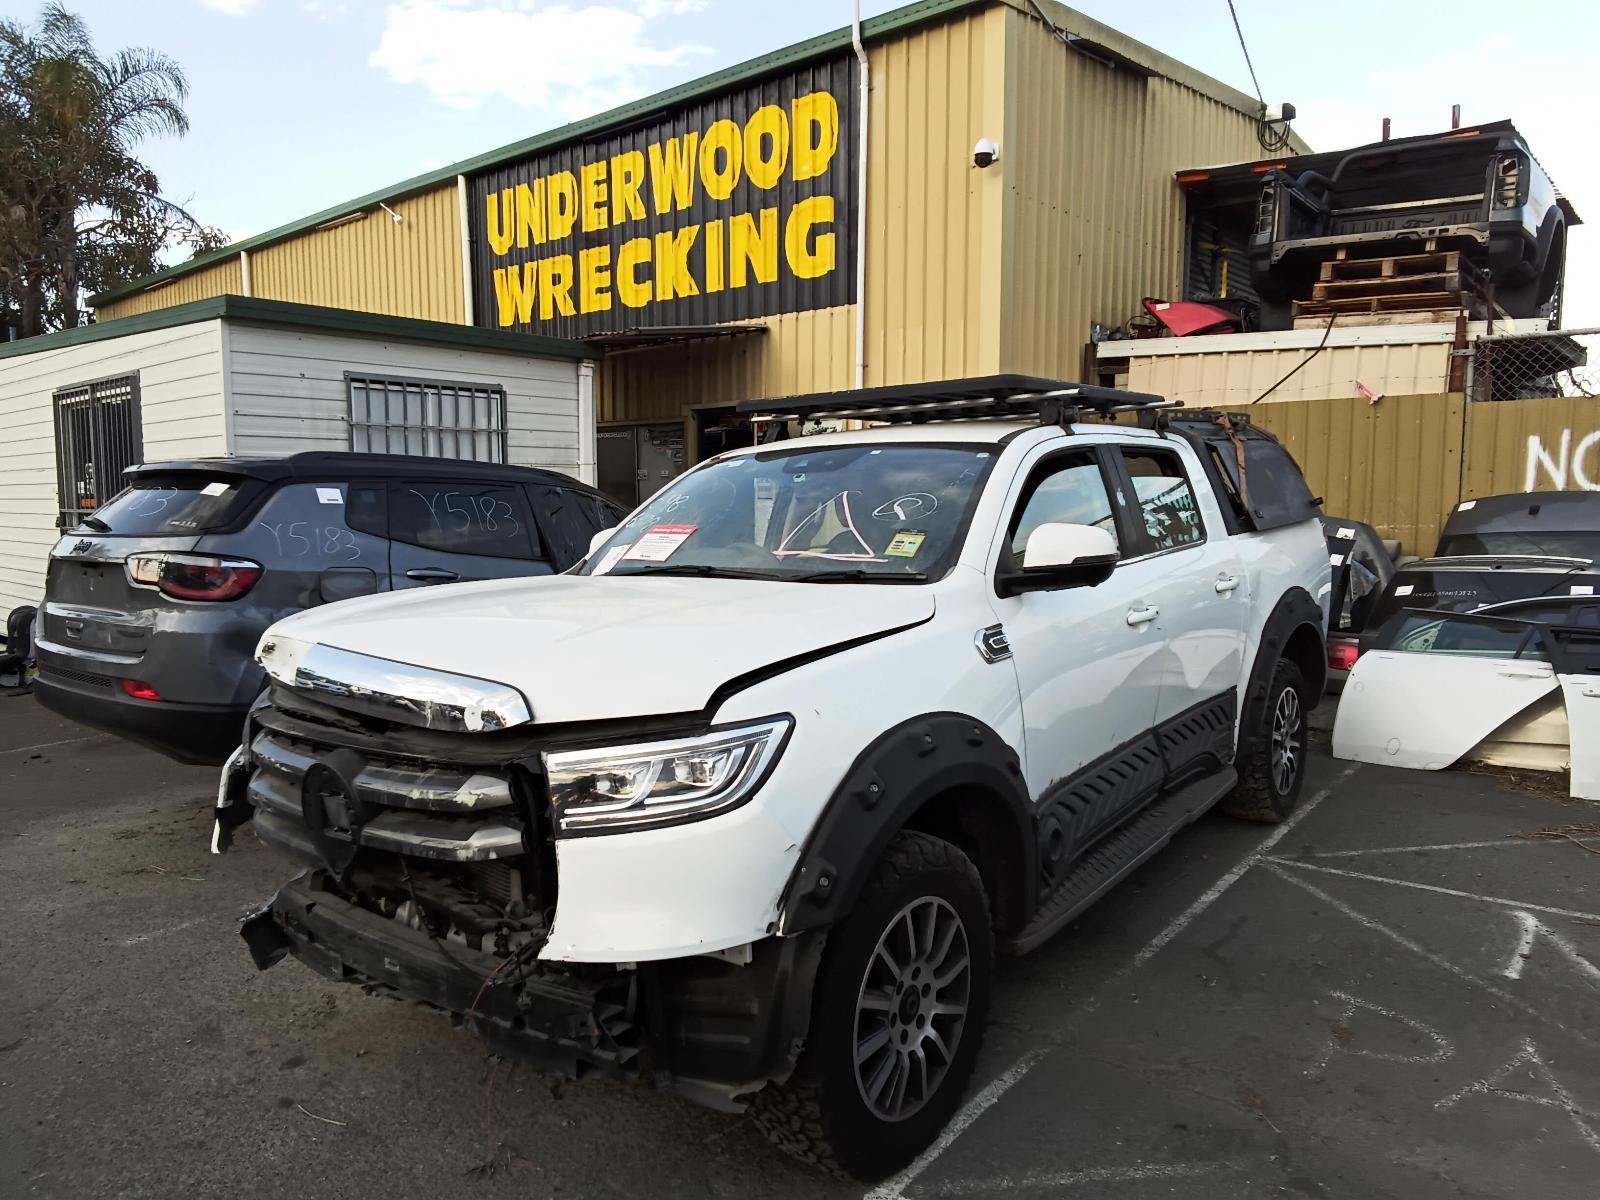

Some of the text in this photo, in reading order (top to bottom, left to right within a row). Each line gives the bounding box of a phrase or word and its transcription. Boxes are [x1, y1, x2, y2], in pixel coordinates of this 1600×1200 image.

[487, 91, 839, 256] UNDERWOOD
[493, 196, 836, 327] WRECKING
[260, 521, 361, 561] Y5183
[410, 489, 519, 537] Y5183
